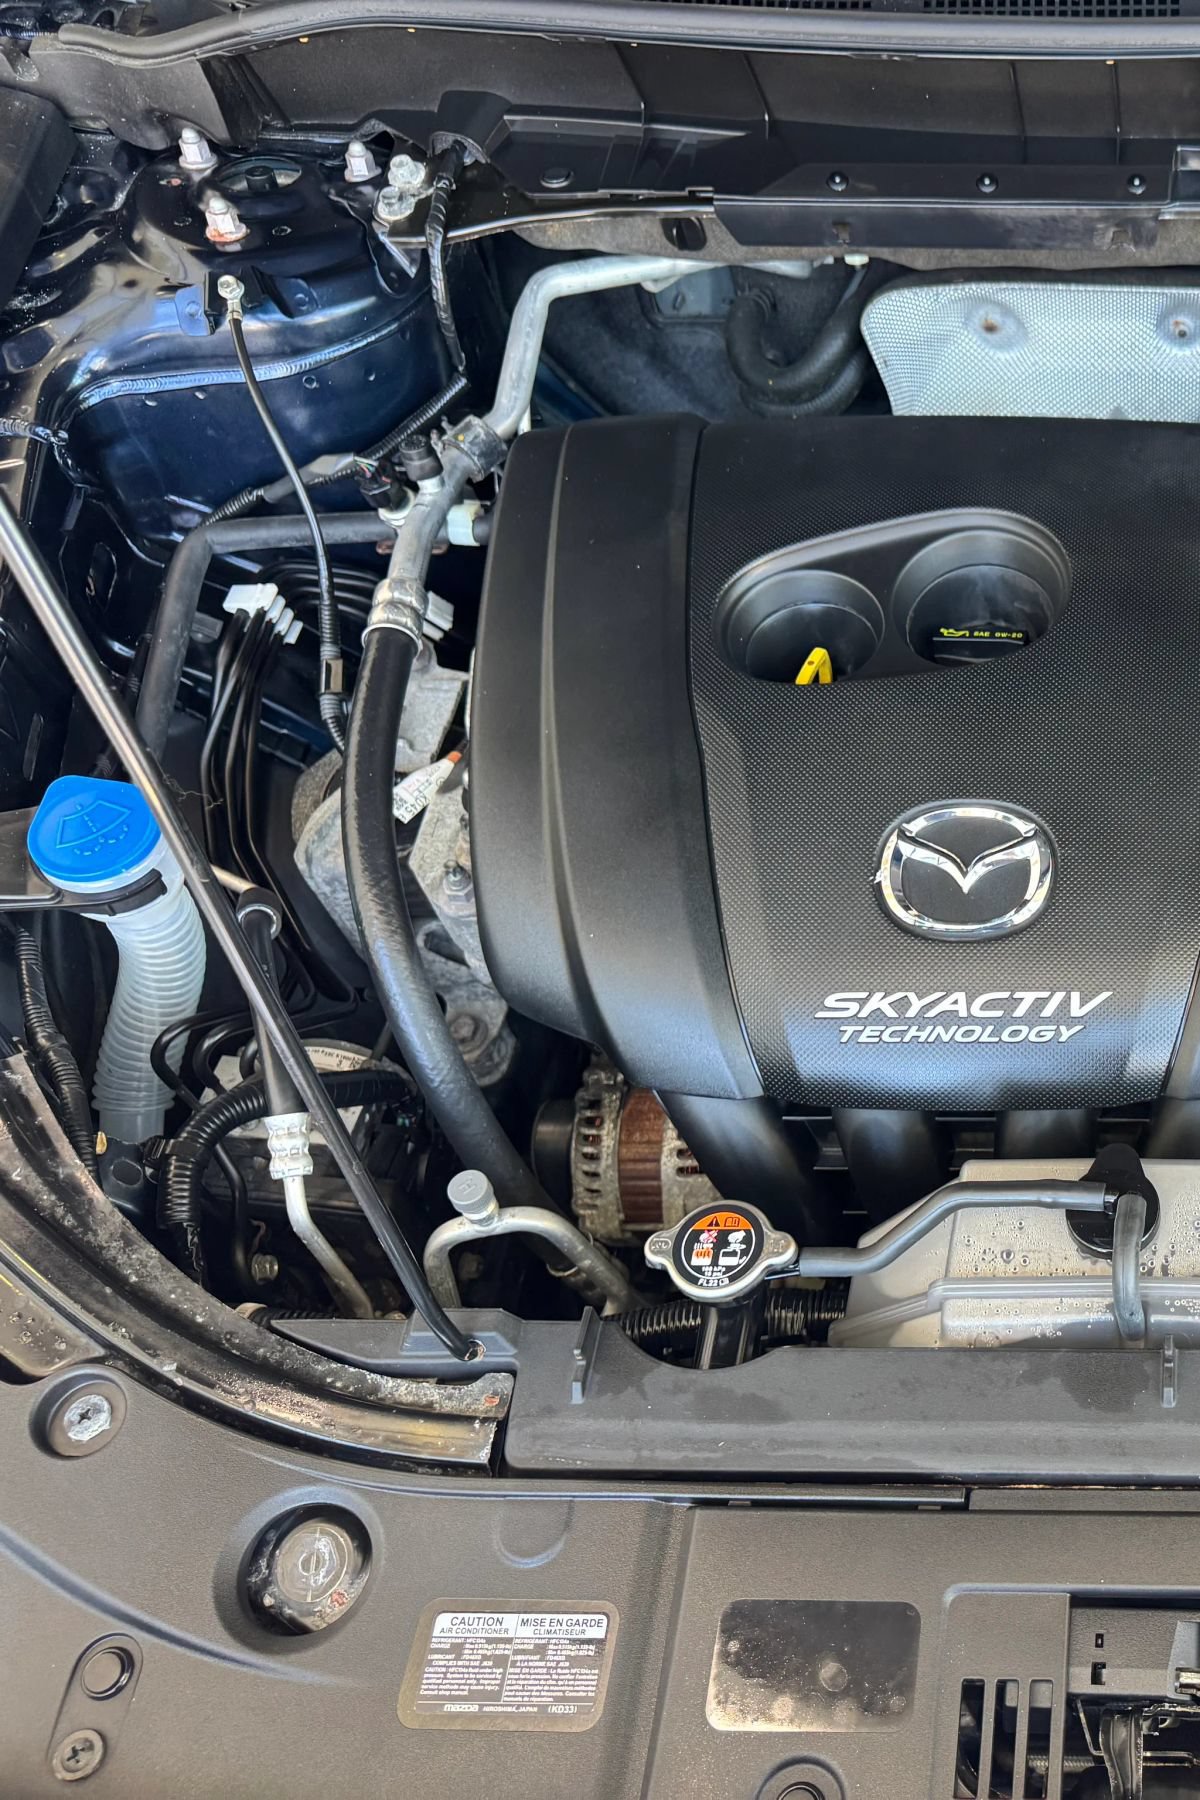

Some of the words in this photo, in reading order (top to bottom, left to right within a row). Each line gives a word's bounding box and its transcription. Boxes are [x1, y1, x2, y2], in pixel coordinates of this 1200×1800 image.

[814, 991, 1114, 1018] SKYACTIV
[839, 1025, 1084, 1043] TECHNOLOGY
[698, 1278, 718, 1286] FL22
[450, 1616, 504, 1626] CAUTION
[520, 1618, 547, 1627] MISE
[548, 1618, 564, 1627] EN
[566, 1618, 604, 1628] GARDE
[548, 1705, 578, 1713] (KD33)
